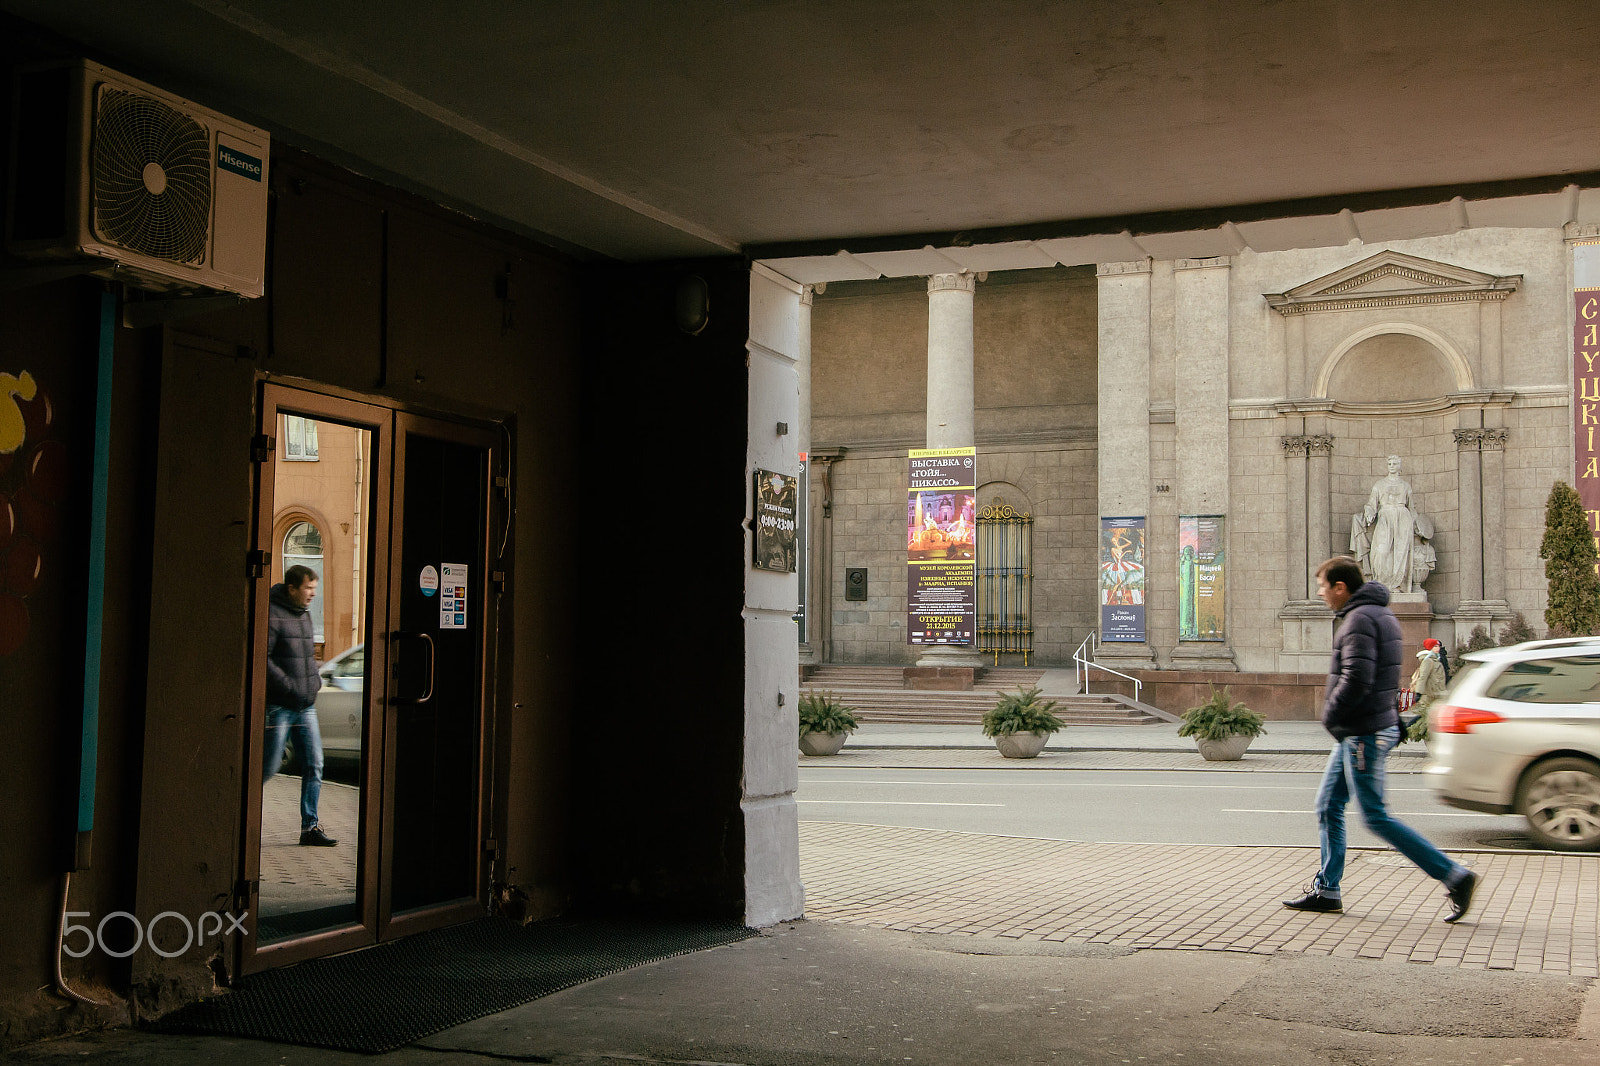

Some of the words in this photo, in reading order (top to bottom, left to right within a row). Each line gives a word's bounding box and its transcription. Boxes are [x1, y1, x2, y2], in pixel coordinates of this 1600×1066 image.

[220, 151, 260, 174] Hisense
[911, 458, 960, 468] ВЫСТАВКА
[911, 478, 960, 488] ПИКАССО»
[761, 514, 794, 531] 9:00-23:00
[919, 615, 963, 623] ОТКРЫТИЕ
